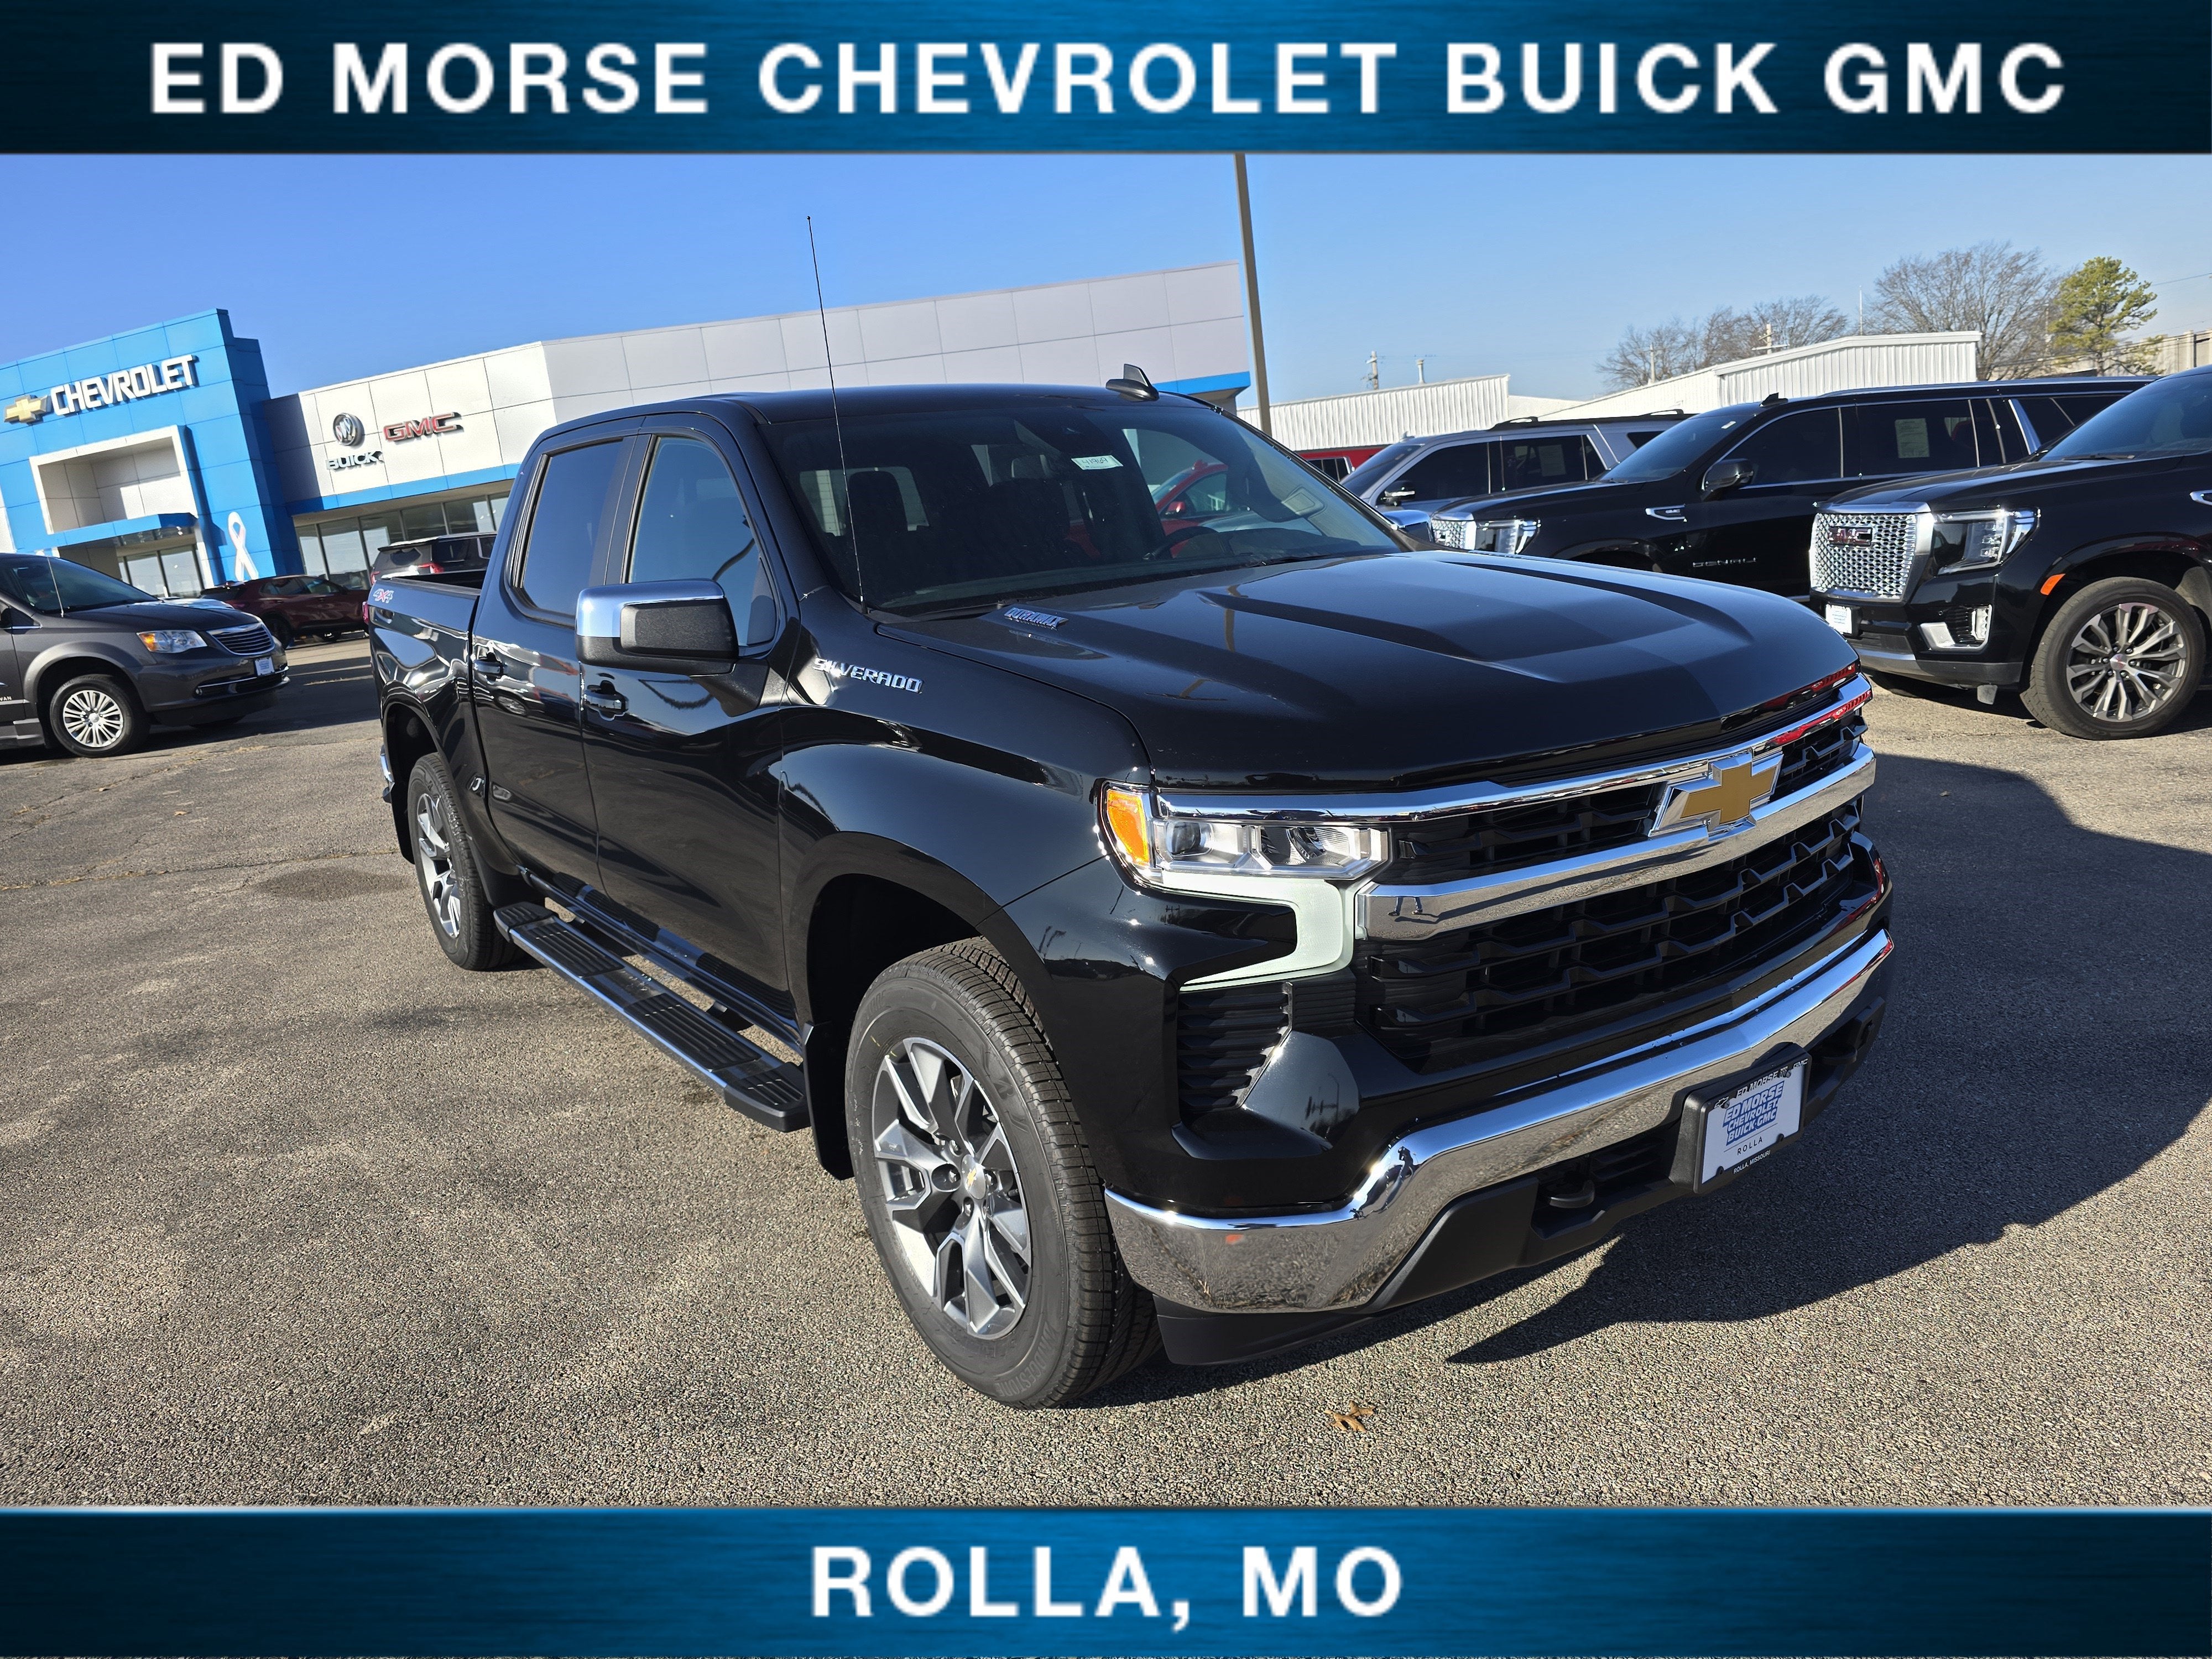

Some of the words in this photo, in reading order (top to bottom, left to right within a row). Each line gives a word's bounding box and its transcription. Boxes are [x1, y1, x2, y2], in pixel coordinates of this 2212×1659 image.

[50, 354, 196, 416] CHEVROLET
[383, 412, 460, 442] GMC
[326, 451, 381, 469] BUICK
[1004, 607, 1066, 628] DURAMAX
[812, 658, 923, 693] SILVERADO
[1736, 1087, 1748, 1098] ED
[1749, 1071, 1779, 1092] MORSE
[1725, 1104, 1741, 1123] ED
[1741, 1083, 1784, 1113] MORSE
[1728, 1100, 1778, 1131] CHEVROLET
[1738, 1136, 1763, 1156] ROLLA
[1749, 1150, 1771, 1166] MISSOURI
